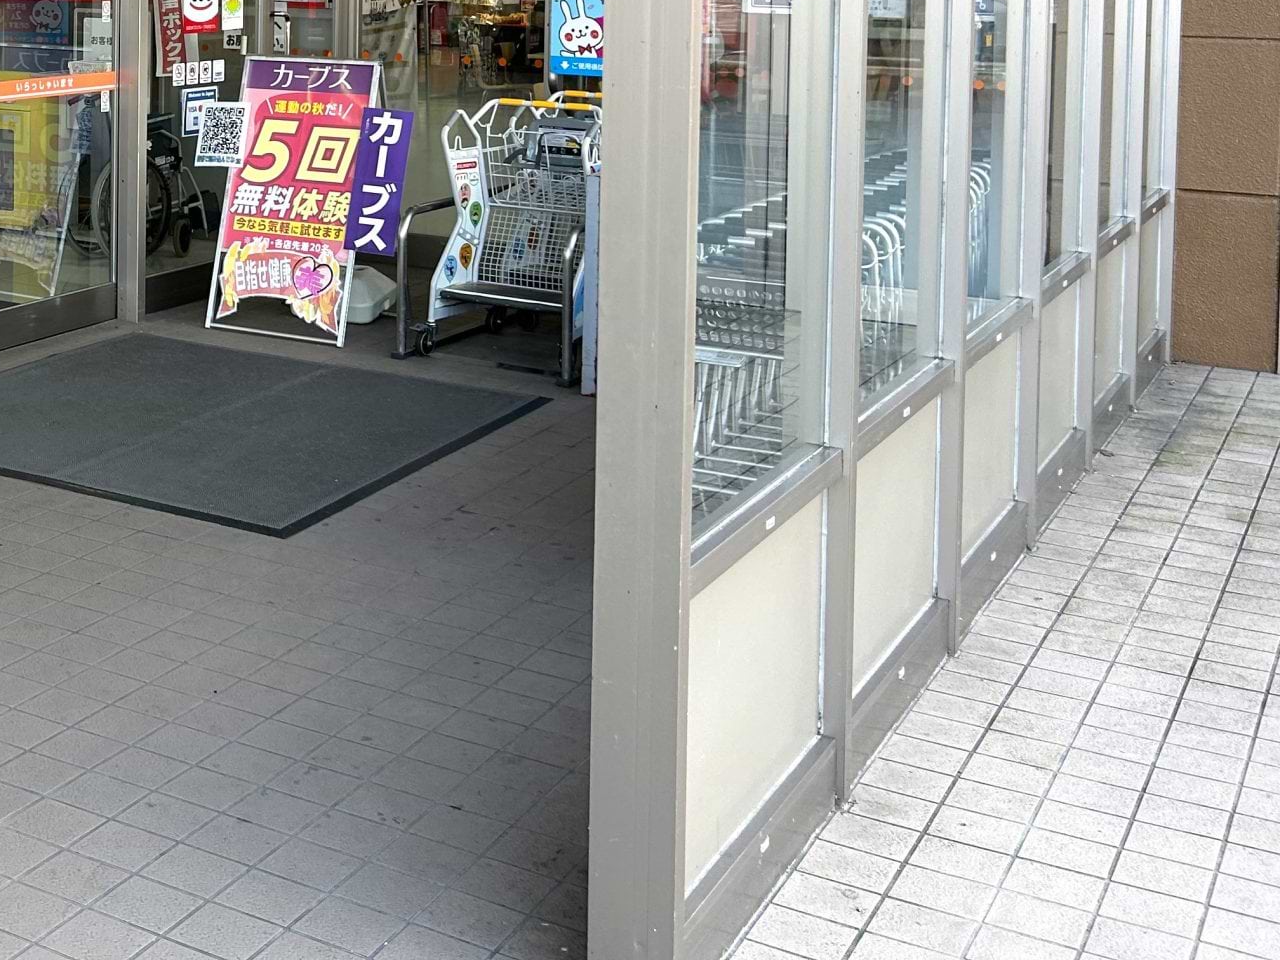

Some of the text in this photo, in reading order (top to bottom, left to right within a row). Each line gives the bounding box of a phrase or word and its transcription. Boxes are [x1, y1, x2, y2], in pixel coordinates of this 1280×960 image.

[15, 78, 74, 92] いらっしゃいませ
[272, 63, 353, 90] カーブス
[274, 98, 344, 118] 運動の秋だ!
[239, 118, 362, 184] 5回
[354, 111, 403, 252] カーブス
[229, 183, 351, 225] 無料体験
[235, 217, 344, 239] 今なら気軽に試せます
[235, 257, 292, 291] 目指せ健康
